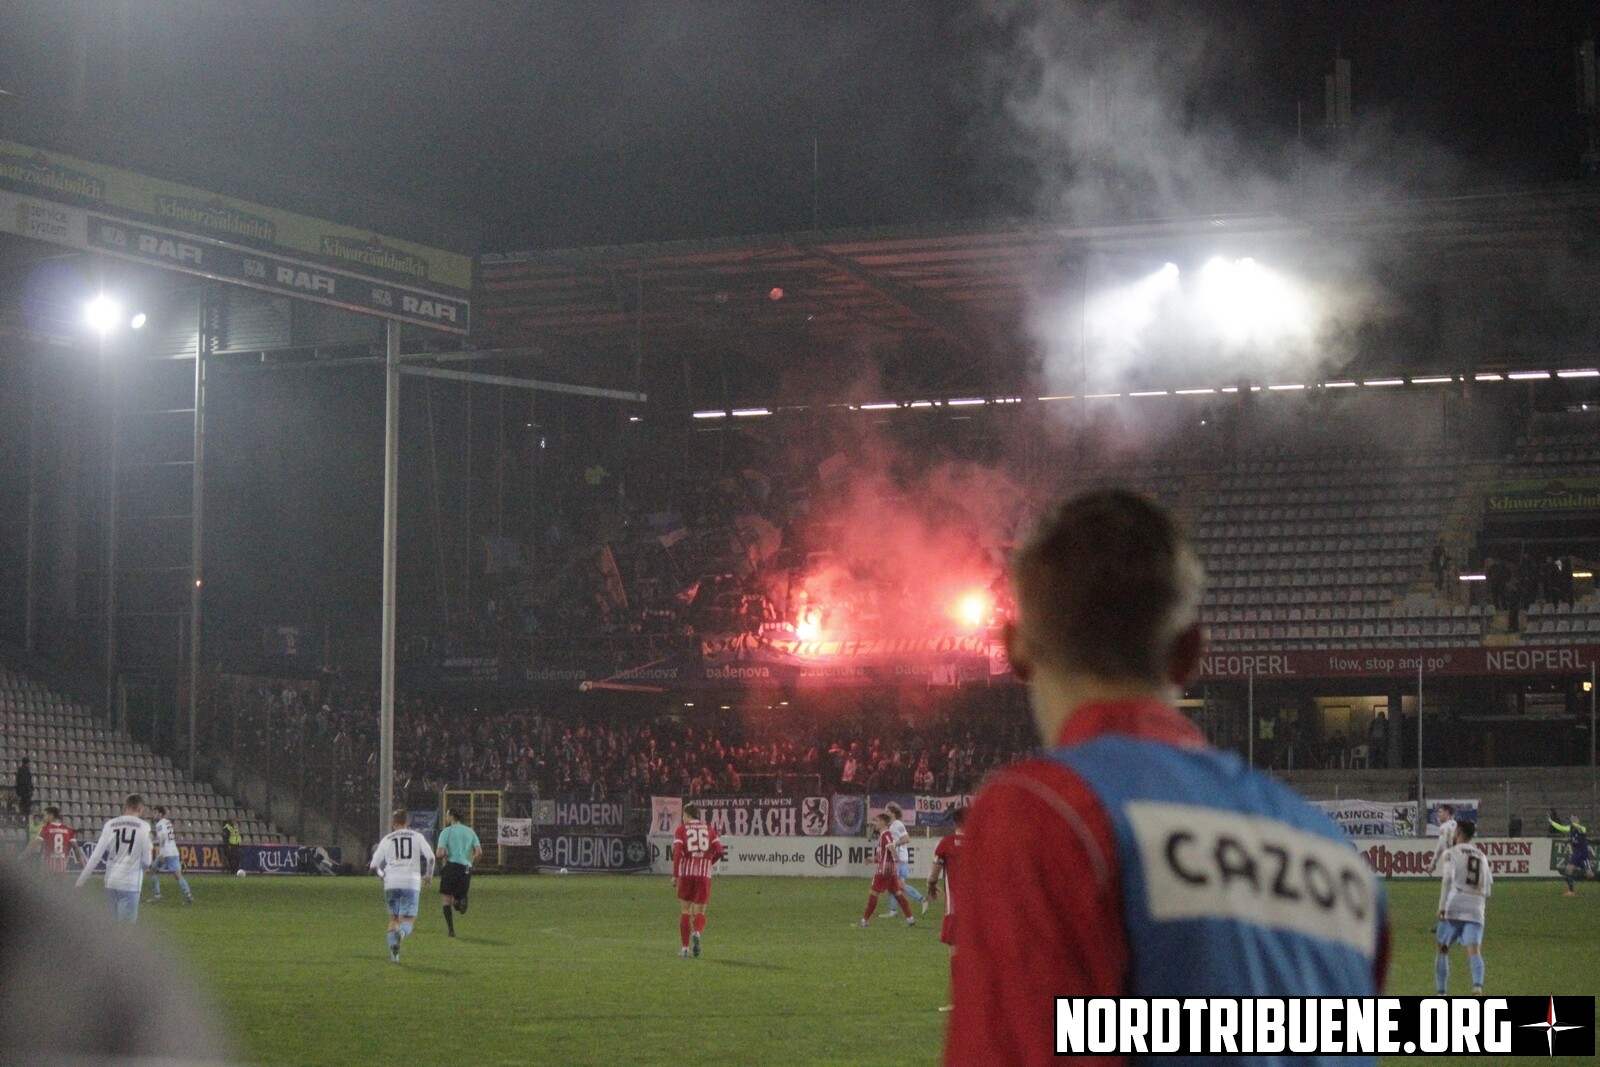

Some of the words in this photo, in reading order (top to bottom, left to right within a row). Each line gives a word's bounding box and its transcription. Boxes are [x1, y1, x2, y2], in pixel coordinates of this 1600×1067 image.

[139, 233, 203, 265] RAFI
[276, 265, 336, 294] RAFI
[402, 295, 457, 322] RAFI
[1199, 655, 1296, 676] NEOPERL
[1330, 655, 1362, 672] flow,
[1366, 656, 1394, 673] stop
[1398, 655, 1423, 670] and
[1486, 649, 1586, 671] NEOPERL
[555, 803, 622, 825] HADERN
[918, 798, 942, 811] 1860
[699, 808, 796, 836] IMBACH
[53, 834, 64, 855] 8
[113, 828, 136, 856] 14
[391, 837, 413, 860] 10
[554, 836, 624, 867] AUBING
[685, 829, 710, 852] 26
[739, 852, 805, 863] www.ahp.de
[1163, 828, 1371, 922] CAZOO
[1465, 856, 1480, 886] 9
